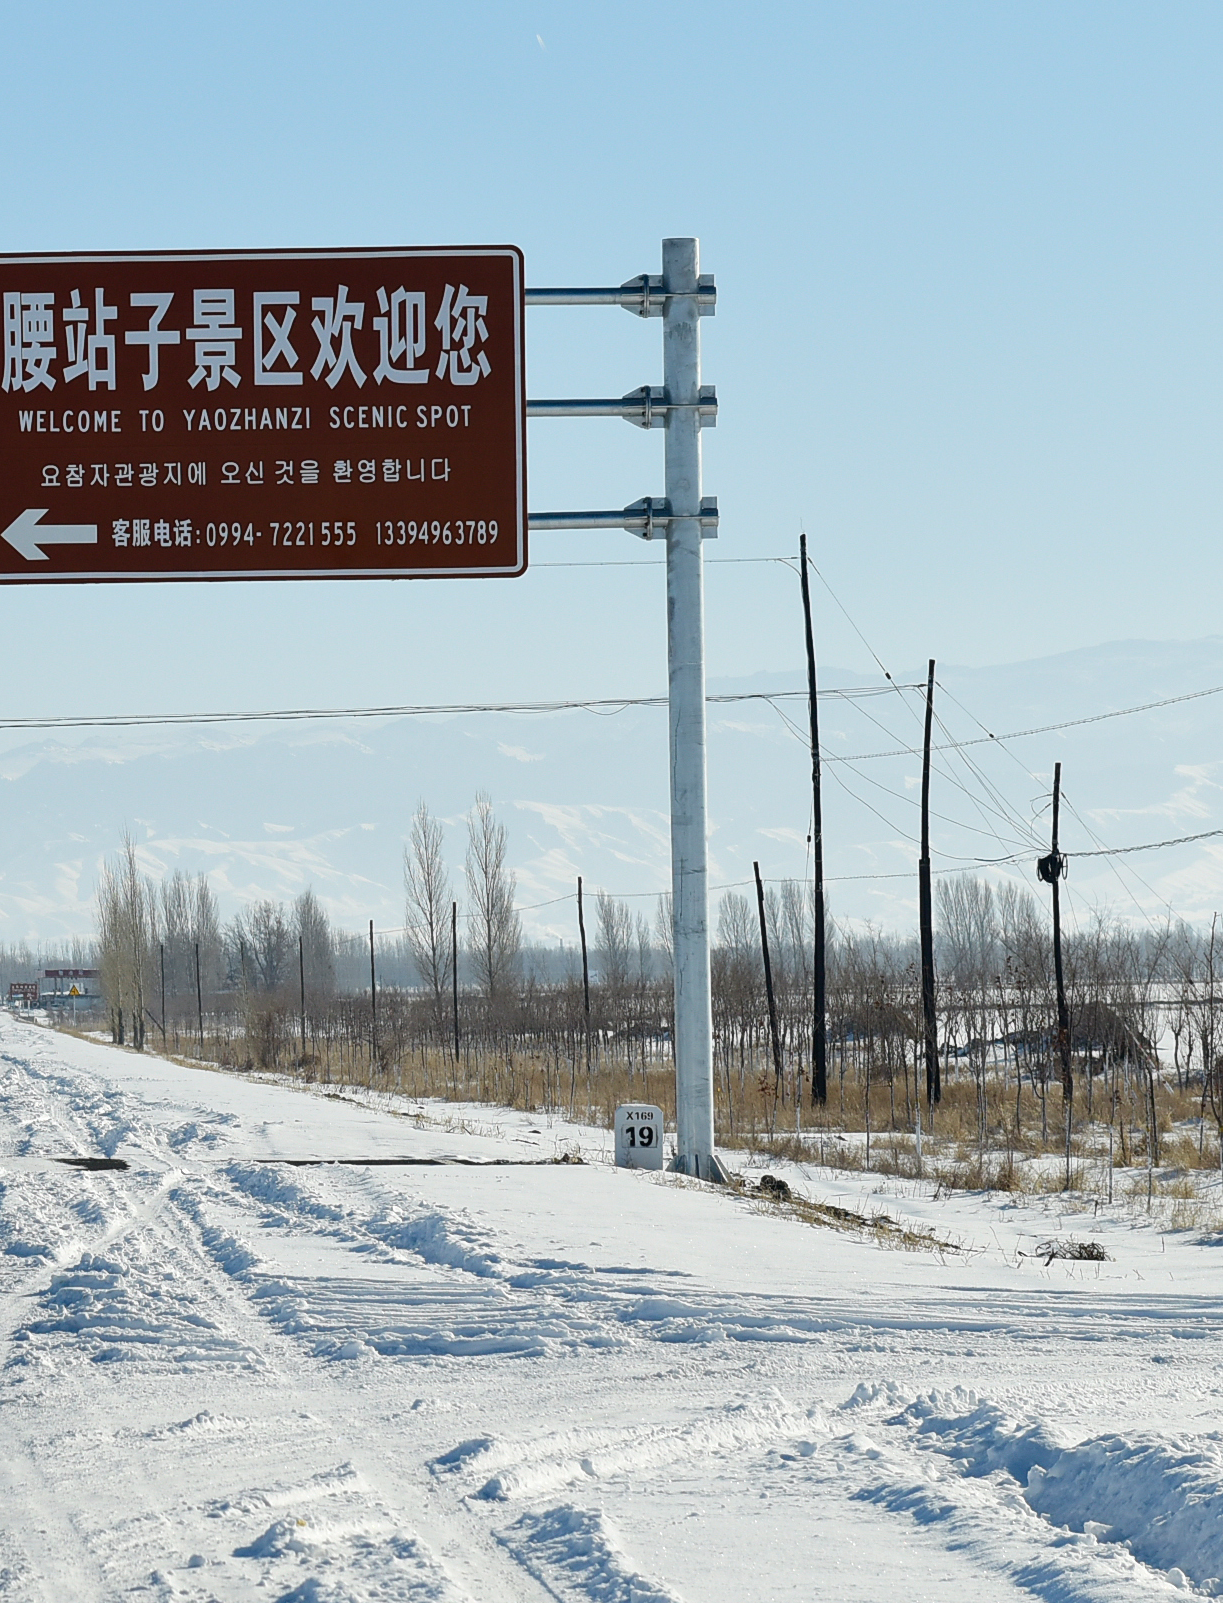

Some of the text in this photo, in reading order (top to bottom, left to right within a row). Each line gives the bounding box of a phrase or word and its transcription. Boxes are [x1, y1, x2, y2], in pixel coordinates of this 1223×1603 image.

[1, 283, 492, 394] 腰站子景区欢迎您
[18, 404, 472, 433] WELCOME TO YAOZHANZI SCENIC SPOT
[40, 457, 452, 488] 요참자관광지에 오신 것을 환영합니다
[376, 519, 499, 545] 13394963789
[626, 1111, 654, 1121] X169
[625, 1126, 654, 1147] 19
